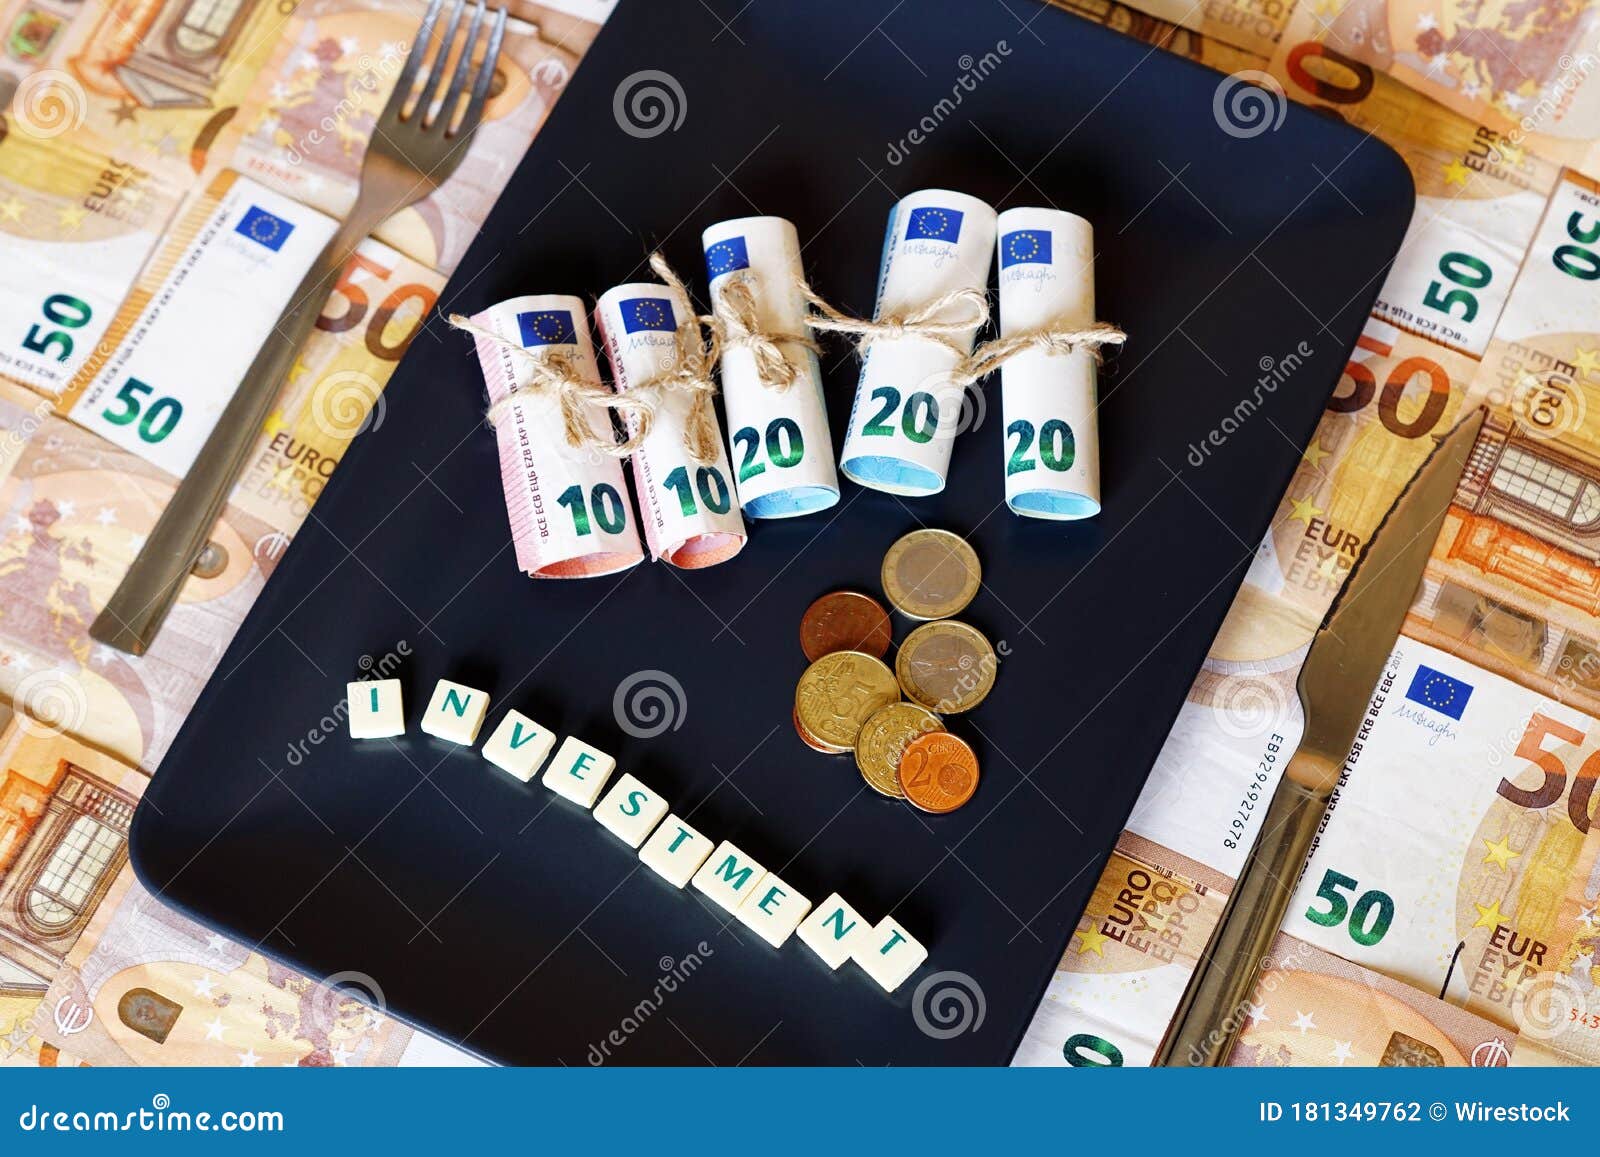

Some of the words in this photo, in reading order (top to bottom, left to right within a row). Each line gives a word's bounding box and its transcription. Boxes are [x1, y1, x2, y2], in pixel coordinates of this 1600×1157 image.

[314, 251, 442, 362] 50
[1422, 251, 1494, 324] 50
[22, 292, 93, 362] 50
[102, 377, 184, 444] 50
[861, 386, 939, 445] 20
[1326, 333, 1451, 439] 50
[269, 431, 338, 478] EURO
[517, 426, 529, 447] EKP
[522, 448, 534, 468] EZB
[732, 417, 805, 484] 20
[1007, 418, 1076, 477] 20
[531, 493, 543, 515] ECB
[556, 482, 626, 536] 10
[663, 465, 732, 518] 10
[1304, 517, 1361, 558] EUR
[1336, 764, 1353, 787] EKT
[1346, 741, 1364, 764] ESB
[1357, 717, 1374, 741] EKB
[1379, 670, 1397, 694] EBC
[906, 746, 931, 788] 2
[1223, 732, 1284, 850] EB9294927678
[369, 686, 908, 957] INVESTMENT
[1100, 869, 1152, 943] EURO
[1305, 867, 1396, 948] 50
[1489, 924, 1549, 967] EUR
